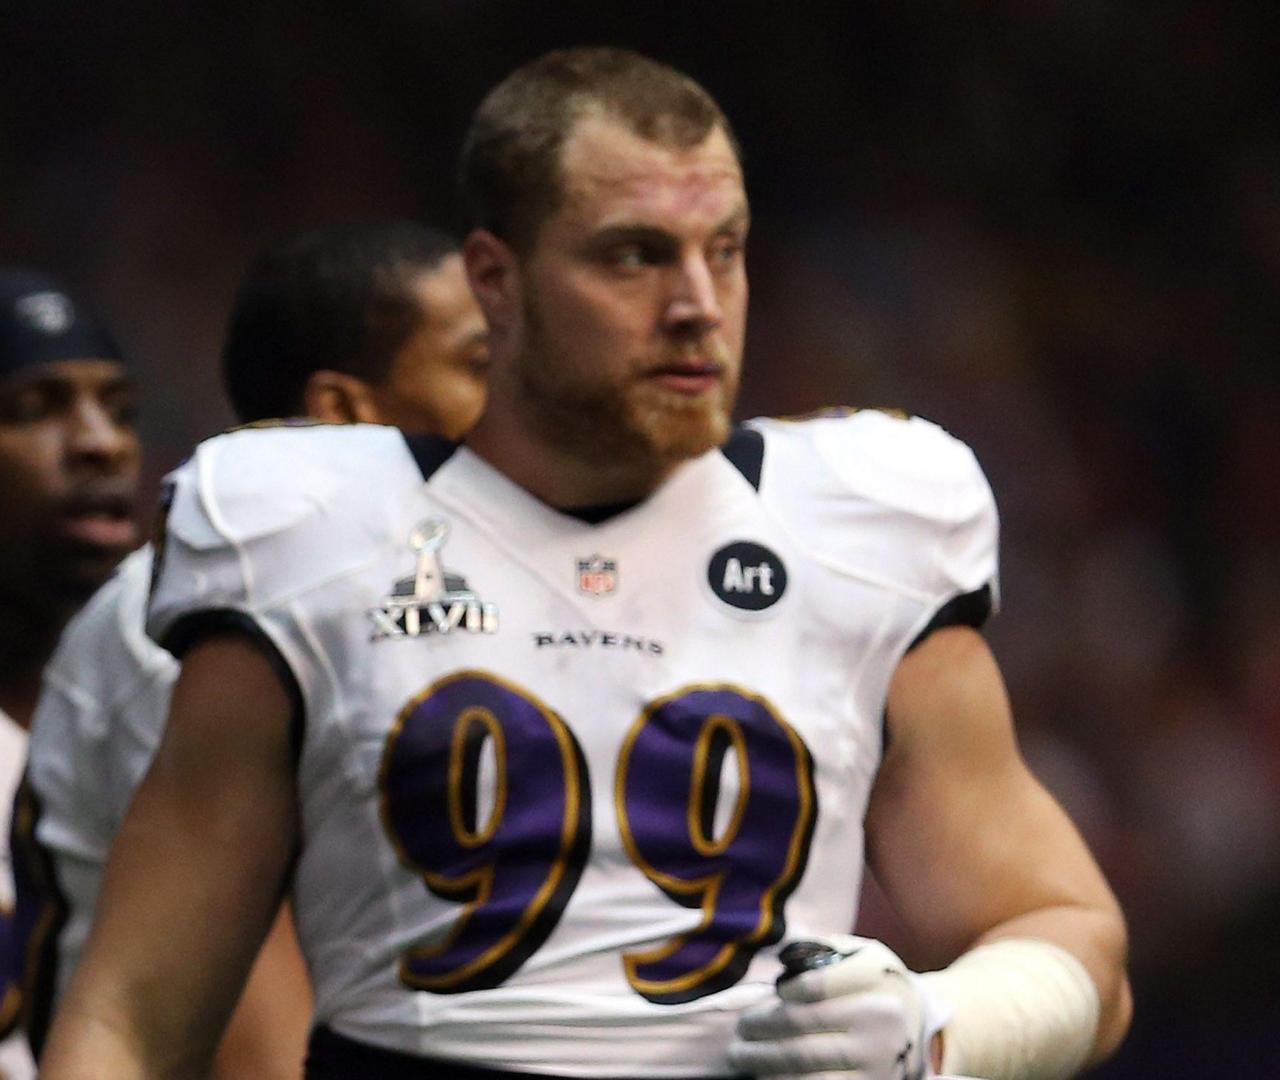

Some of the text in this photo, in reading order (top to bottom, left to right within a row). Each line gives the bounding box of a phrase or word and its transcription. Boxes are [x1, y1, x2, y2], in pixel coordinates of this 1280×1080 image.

[721, 557, 775, 597] Art
[367, 600, 499, 642] XLVII
[533, 631, 664, 655] RAVENS
[378, 668, 818, 1004] 99
